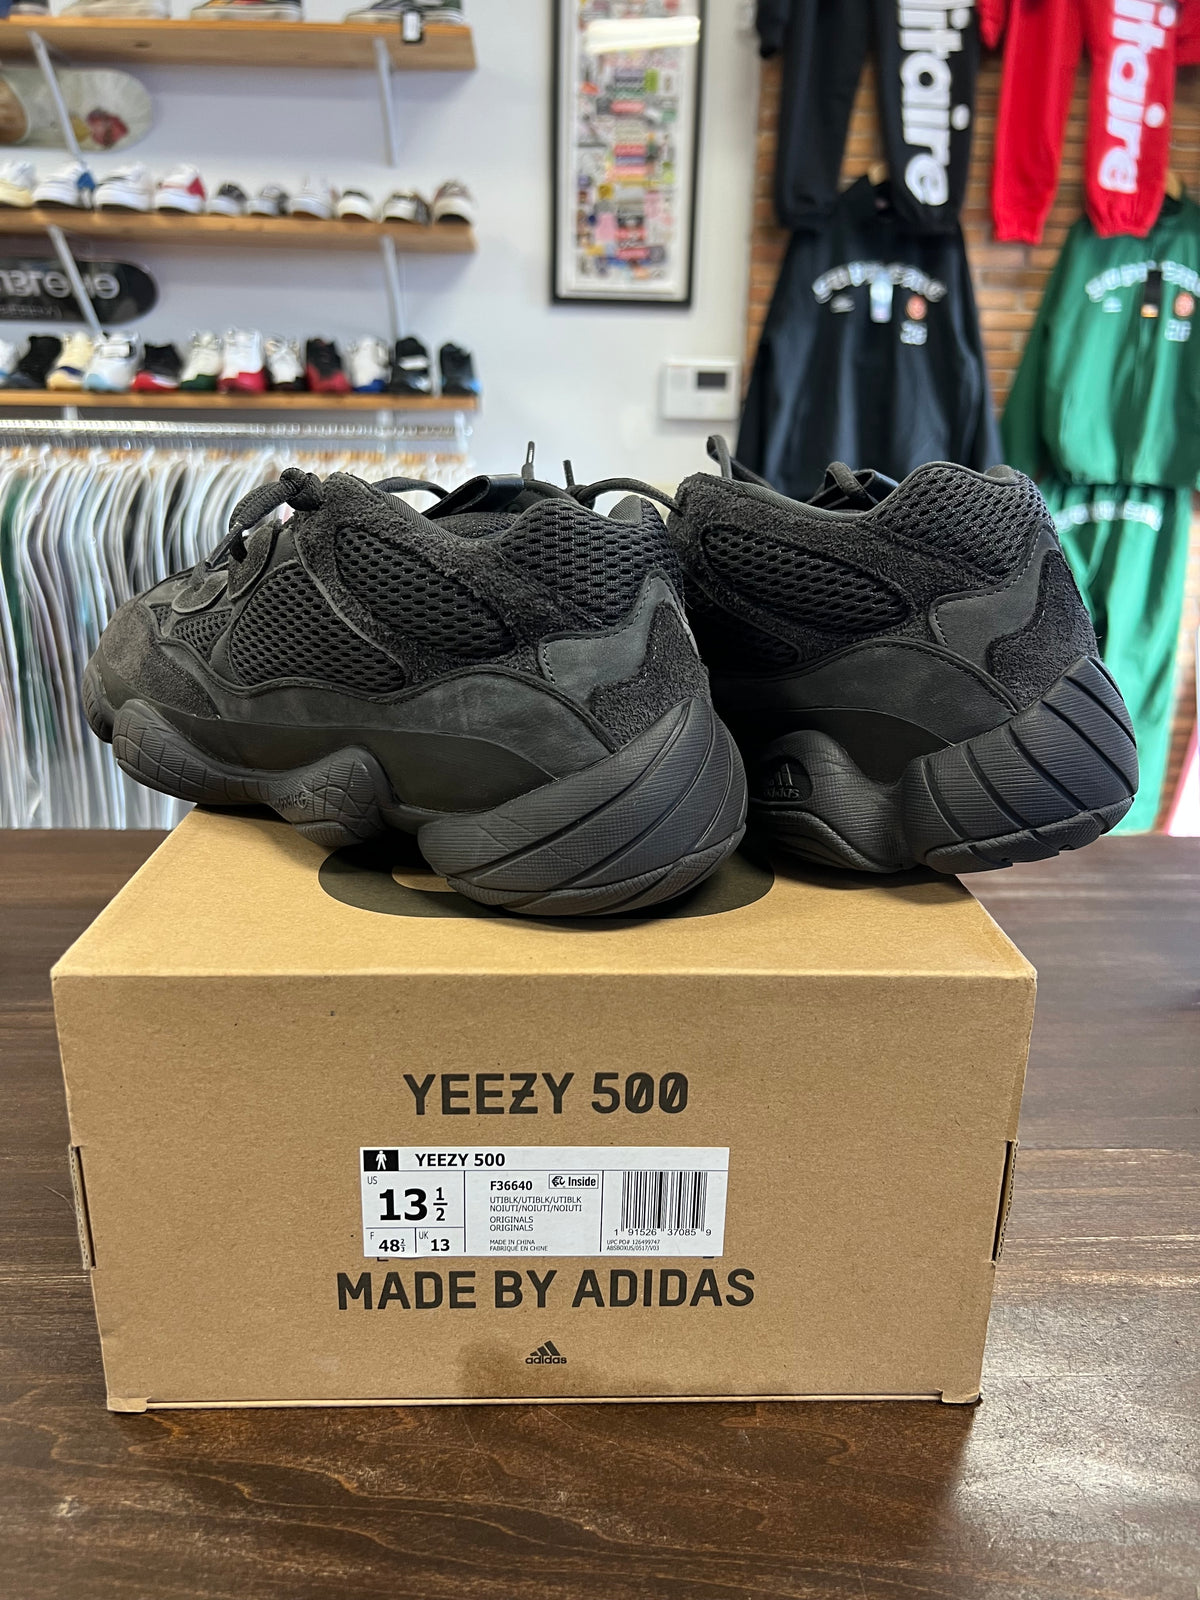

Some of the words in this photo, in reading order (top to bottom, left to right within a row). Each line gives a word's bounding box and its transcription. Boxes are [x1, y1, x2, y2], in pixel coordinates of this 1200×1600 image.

[1098, 0, 1176, 193] itaire
[402, 1072, 575, 1115] YEEZY
[591, 1071, 689, 1114] 500
[415, 1153, 469, 1167] YEEZY
[474, 1153, 506, 1167] 500
[367, 1176, 378, 1185] US
[490, 1180, 533, 1191] F36640
[568, 1176, 596, 1187] Inside
[379, 1188, 428, 1221] 13
[489, 1216, 534, 1224] ORIGINALS
[489, 1224, 534, 1232] ORIGINALS
[370, 1231, 375, 1240] F
[419, 1231, 429, 1240] UK
[431, 1239, 450, 1252] 13
[336, 1270, 476, 1310] MADE
[494, 1269, 558, 1309] BY
[571, 1268, 755, 1308] ADIDAS
[525, 1353, 567, 1365] adidas
